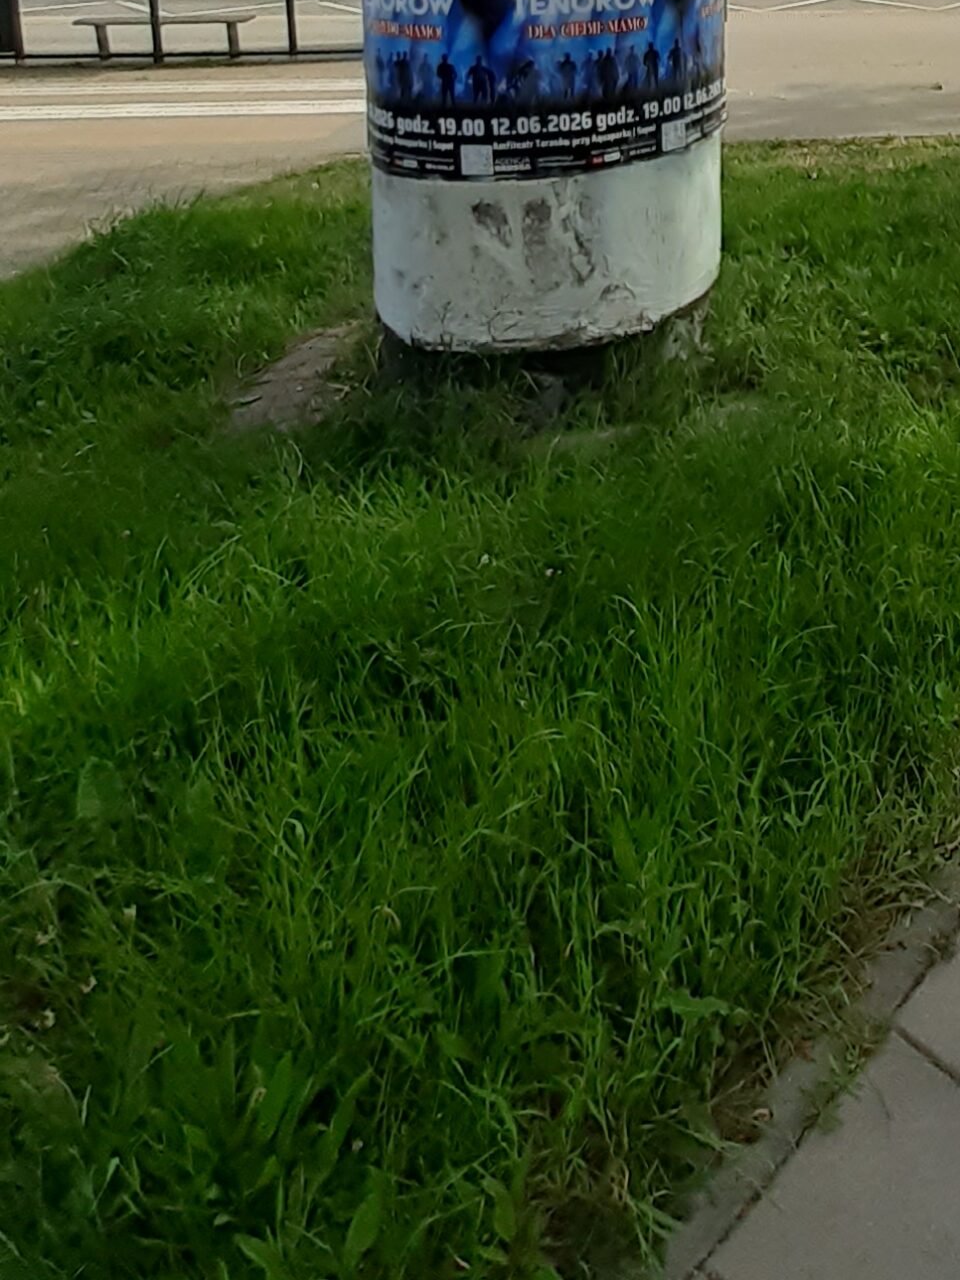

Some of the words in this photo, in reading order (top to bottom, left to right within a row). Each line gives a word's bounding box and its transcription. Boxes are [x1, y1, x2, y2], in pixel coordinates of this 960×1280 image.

[528, 24, 556, 39] DLA
[397, 114, 435, 135] godz.
[438, 117, 485, 136] 19.00
[491, 112, 592, 136] 12.06.2026
[596, 106, 639, 132] godz.
[643, 96, 681, 119] 19.00
